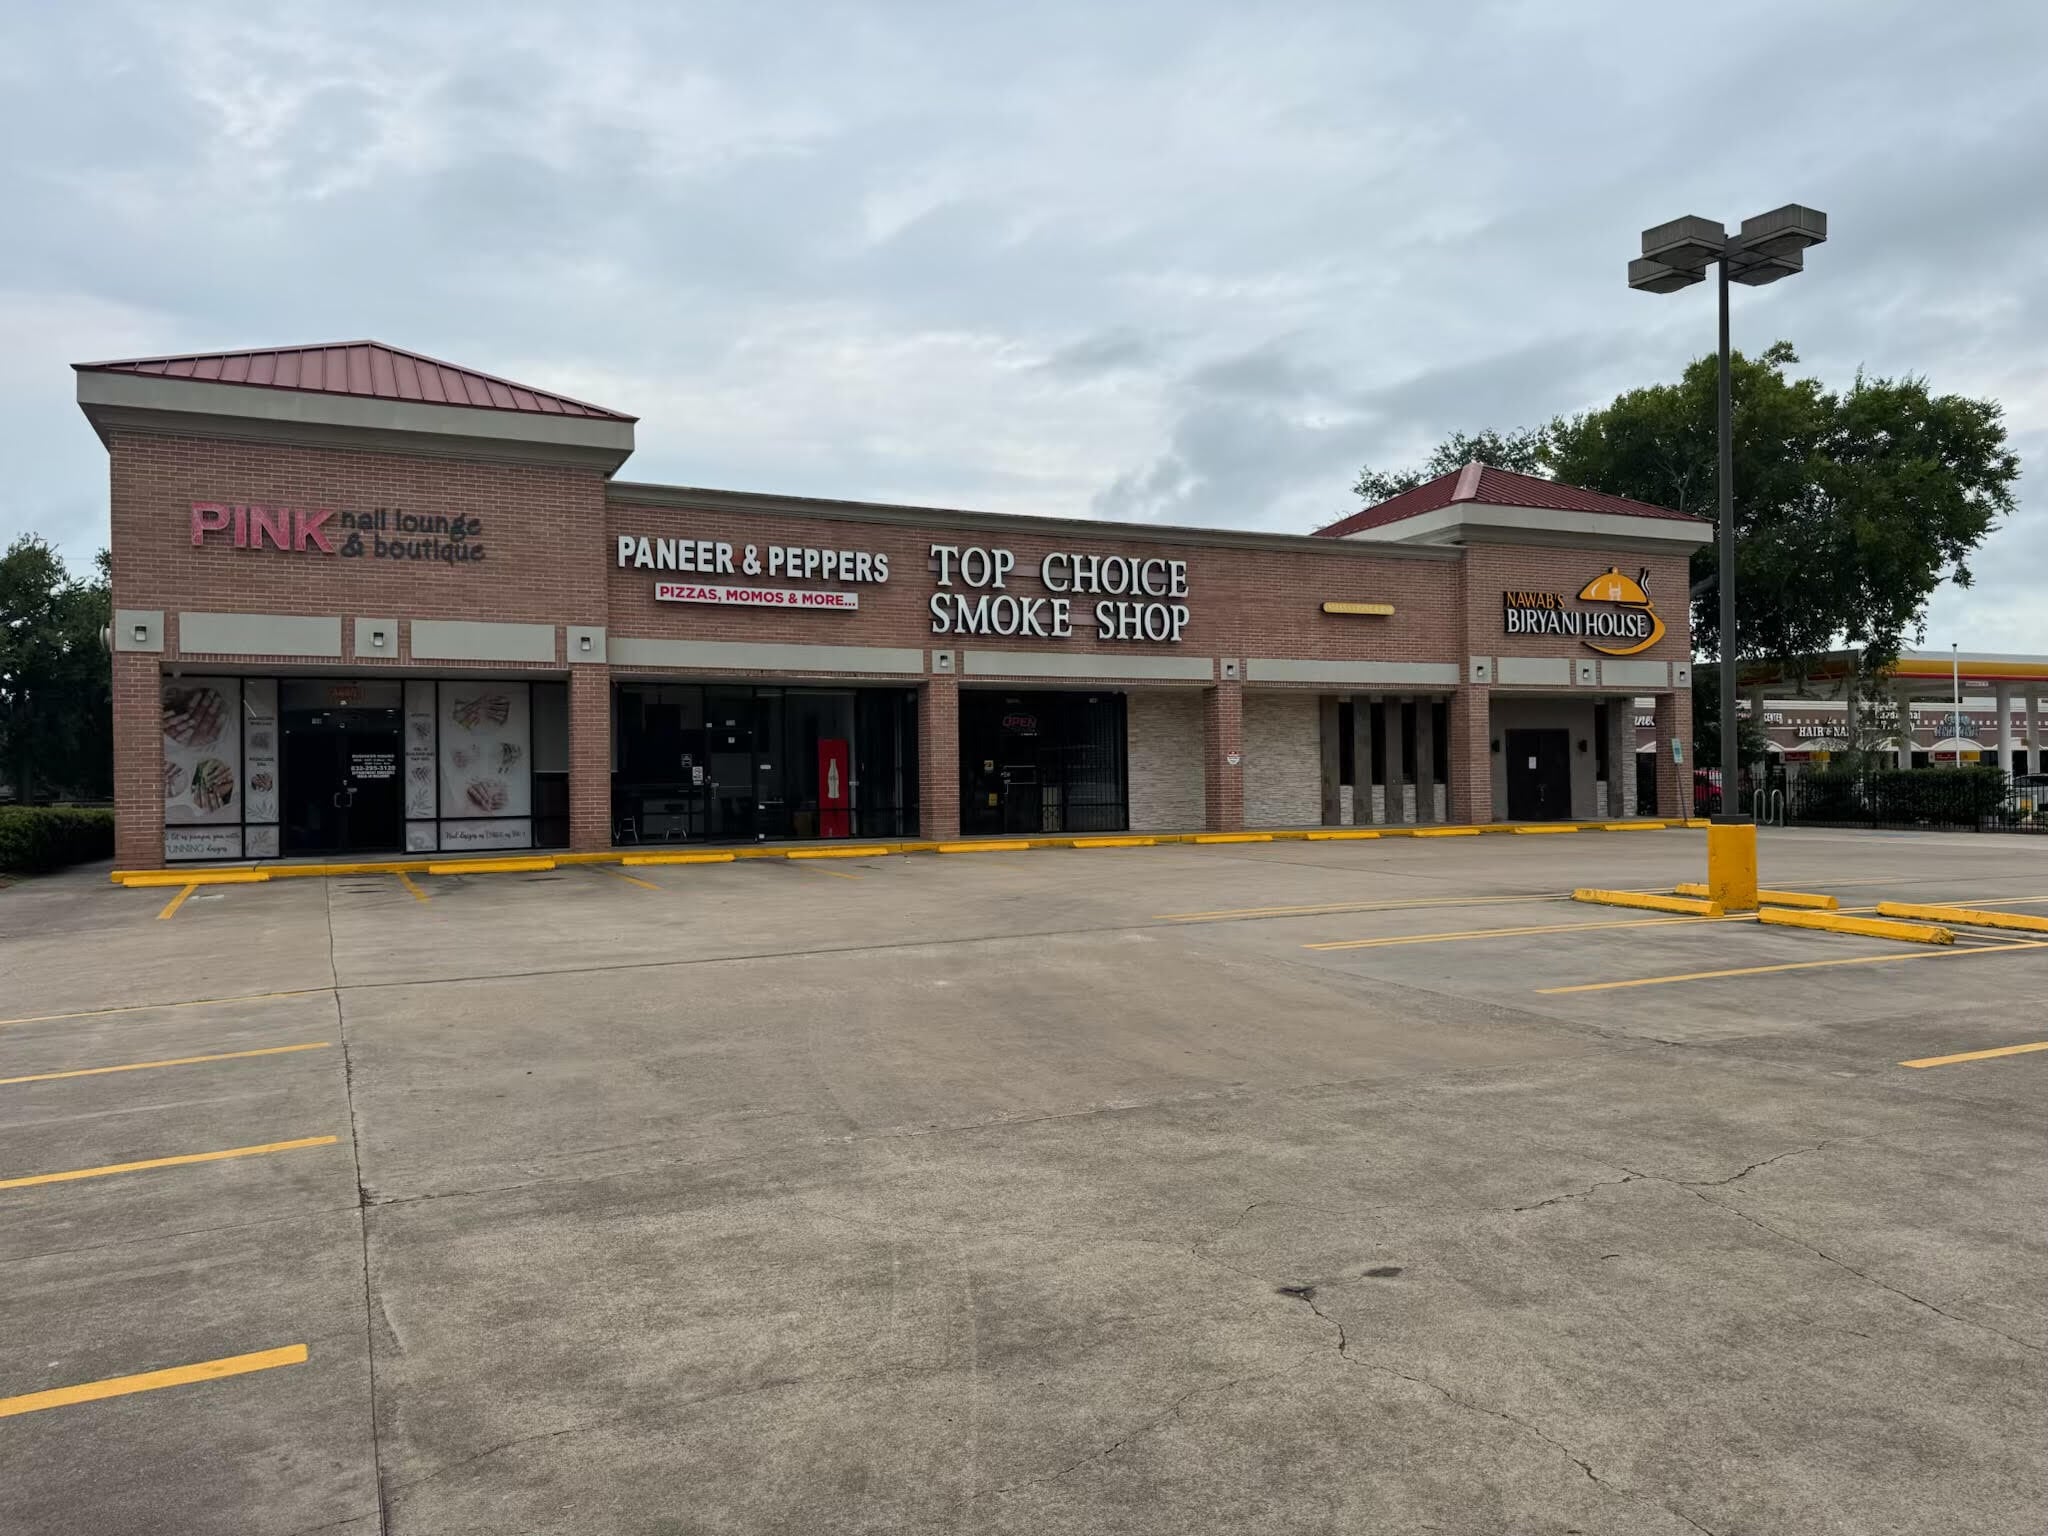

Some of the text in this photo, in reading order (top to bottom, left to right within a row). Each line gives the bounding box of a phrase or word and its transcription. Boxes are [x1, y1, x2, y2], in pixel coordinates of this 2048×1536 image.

[190, 501, 337, 555] PINK
[341, 507, 483, 544] nail lounge
[340, 532, 486, 566] & boutique
[617, 535, 889, 584] PANEER & PEPPERS
[930, 544, 1190, 599] TOP CHOICE
[659, 585, 856, 608] PIZZAS, MOMOS & MORE...
[1506, 591, 1566, 610] NAWAB'S
[930, 592, 1190, 642] SMOKE SHOP
[1507, 608, 1648, 638] BIRYANI HOUSE
[1003, 716, 1036, 727] OPEN
[1763, 712, 1783, 722] CENTER
[1798, 726, 1825, 737] HAIR
